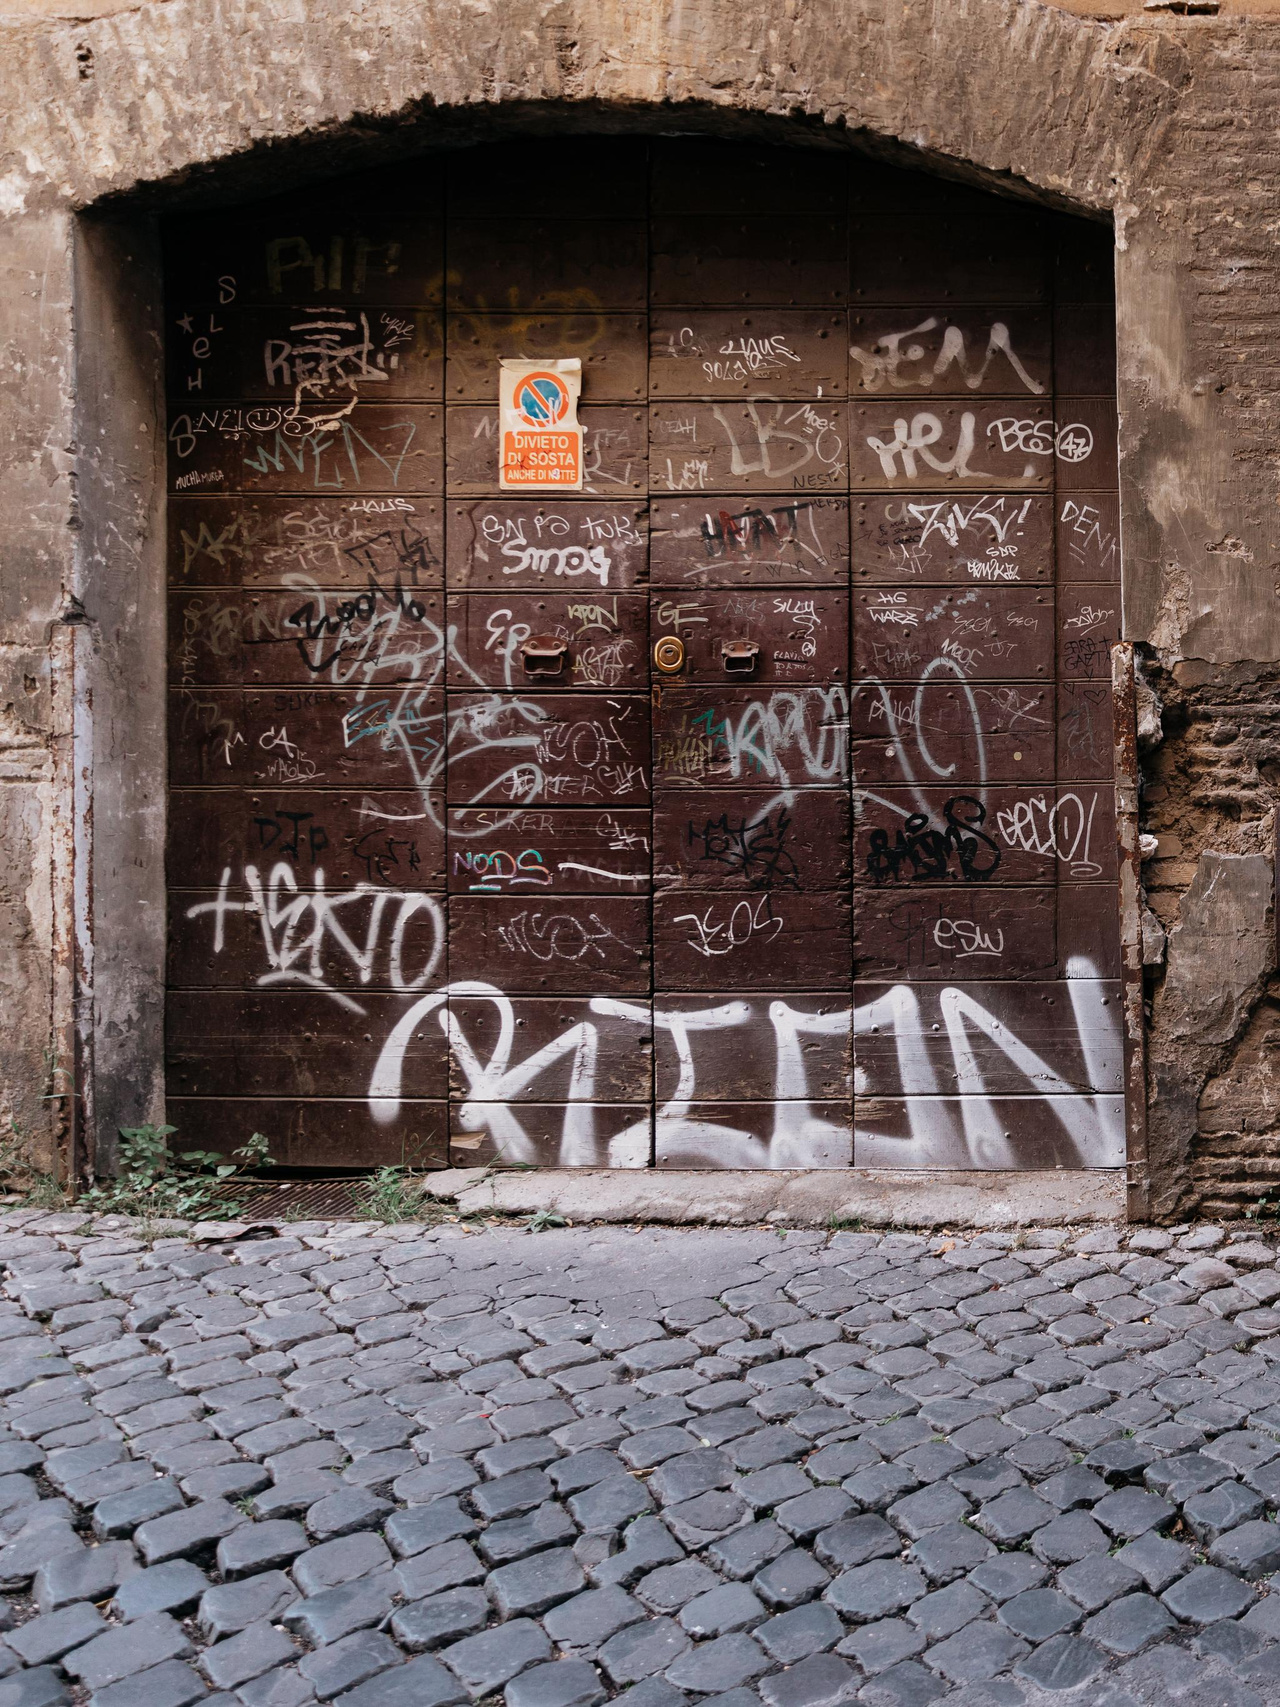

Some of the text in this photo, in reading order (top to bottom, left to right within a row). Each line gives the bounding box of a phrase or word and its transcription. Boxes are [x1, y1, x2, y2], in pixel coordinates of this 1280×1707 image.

[514, 435, 569, 449] DIVIETO
[507, 452, 575, 466] DI SOSTA
[507, 469, 576, 480] ANCHE DI NTTE
[773, 650, 805, 661] FLAVIO
